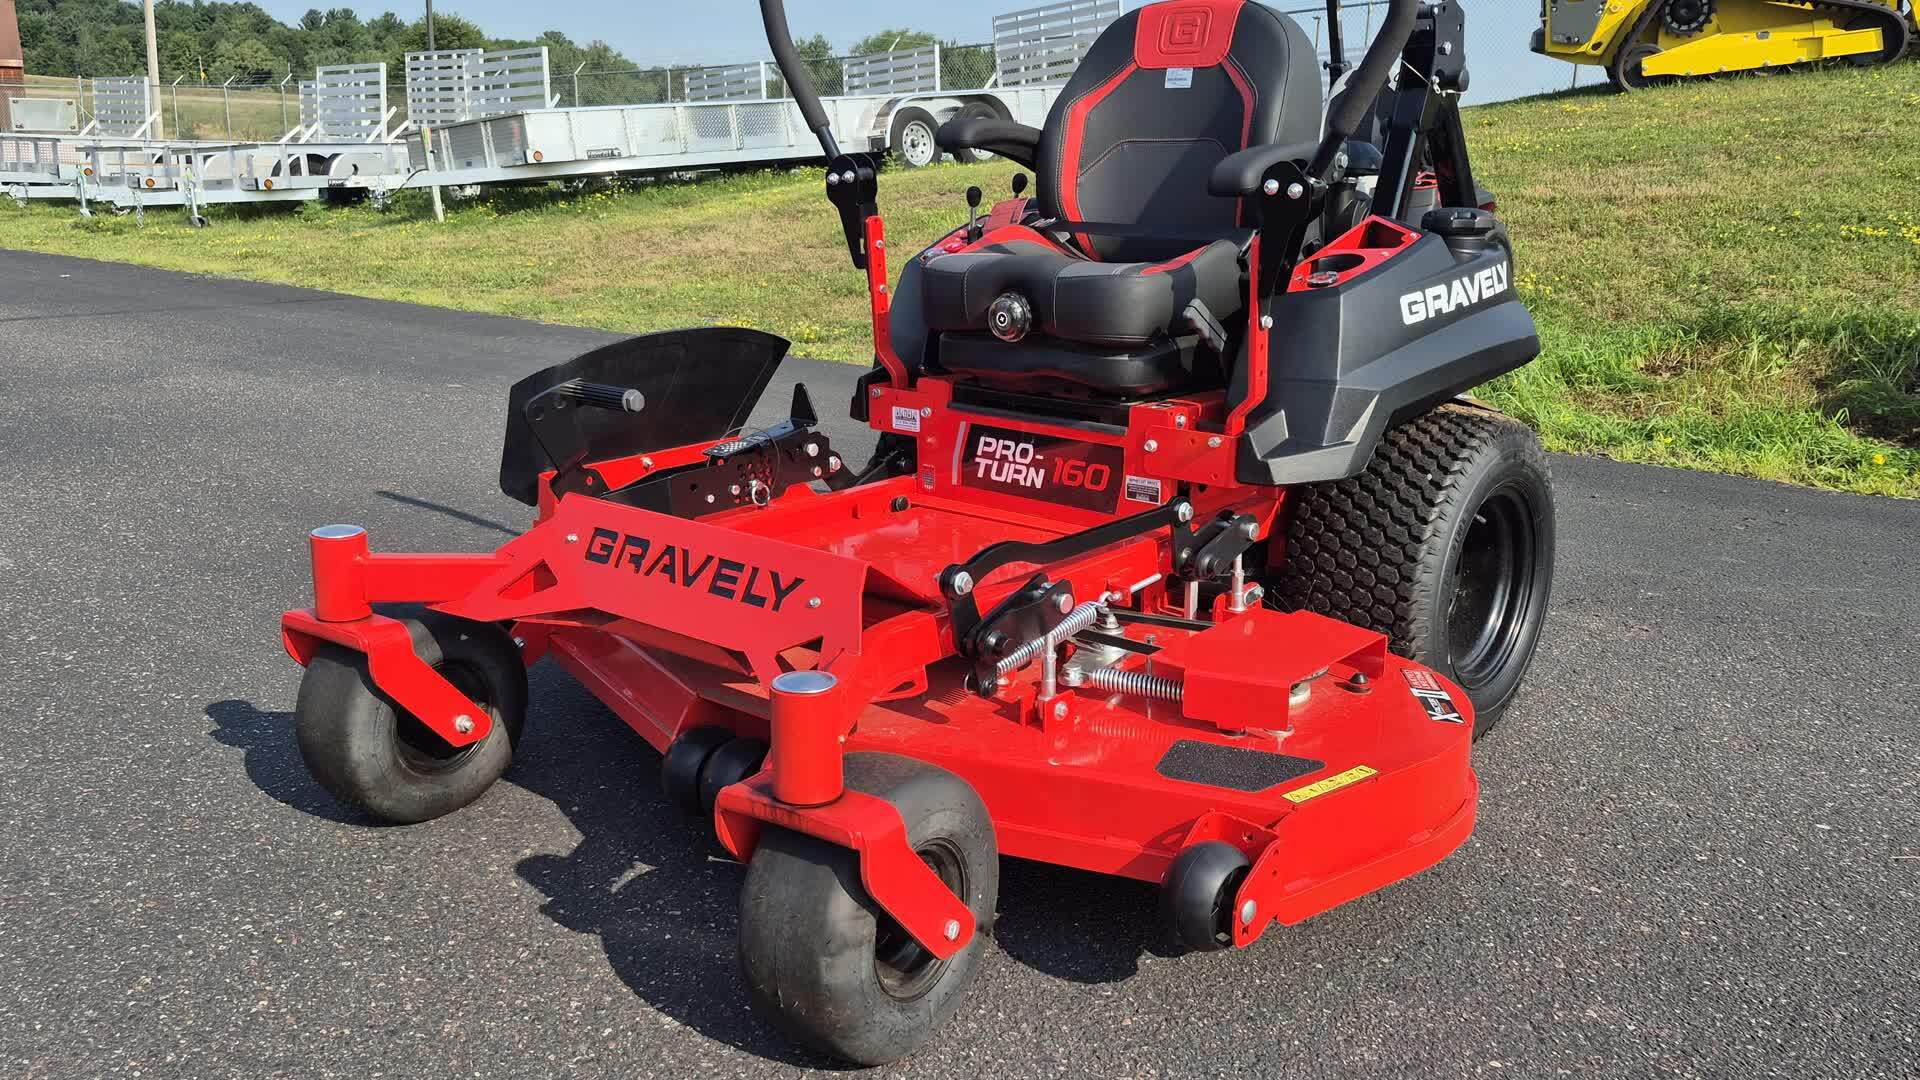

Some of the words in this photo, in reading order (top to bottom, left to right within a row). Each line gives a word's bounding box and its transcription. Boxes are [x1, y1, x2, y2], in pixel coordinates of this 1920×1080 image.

[1400, 261, 1508, 325] GRAVELY
[974, 457, 1045, 489] TURN
[1053, 457, 1110, 491] 160
[976, 436, 1044, 465] PRO-
[585, 526, 805, 613] GRAVELY
